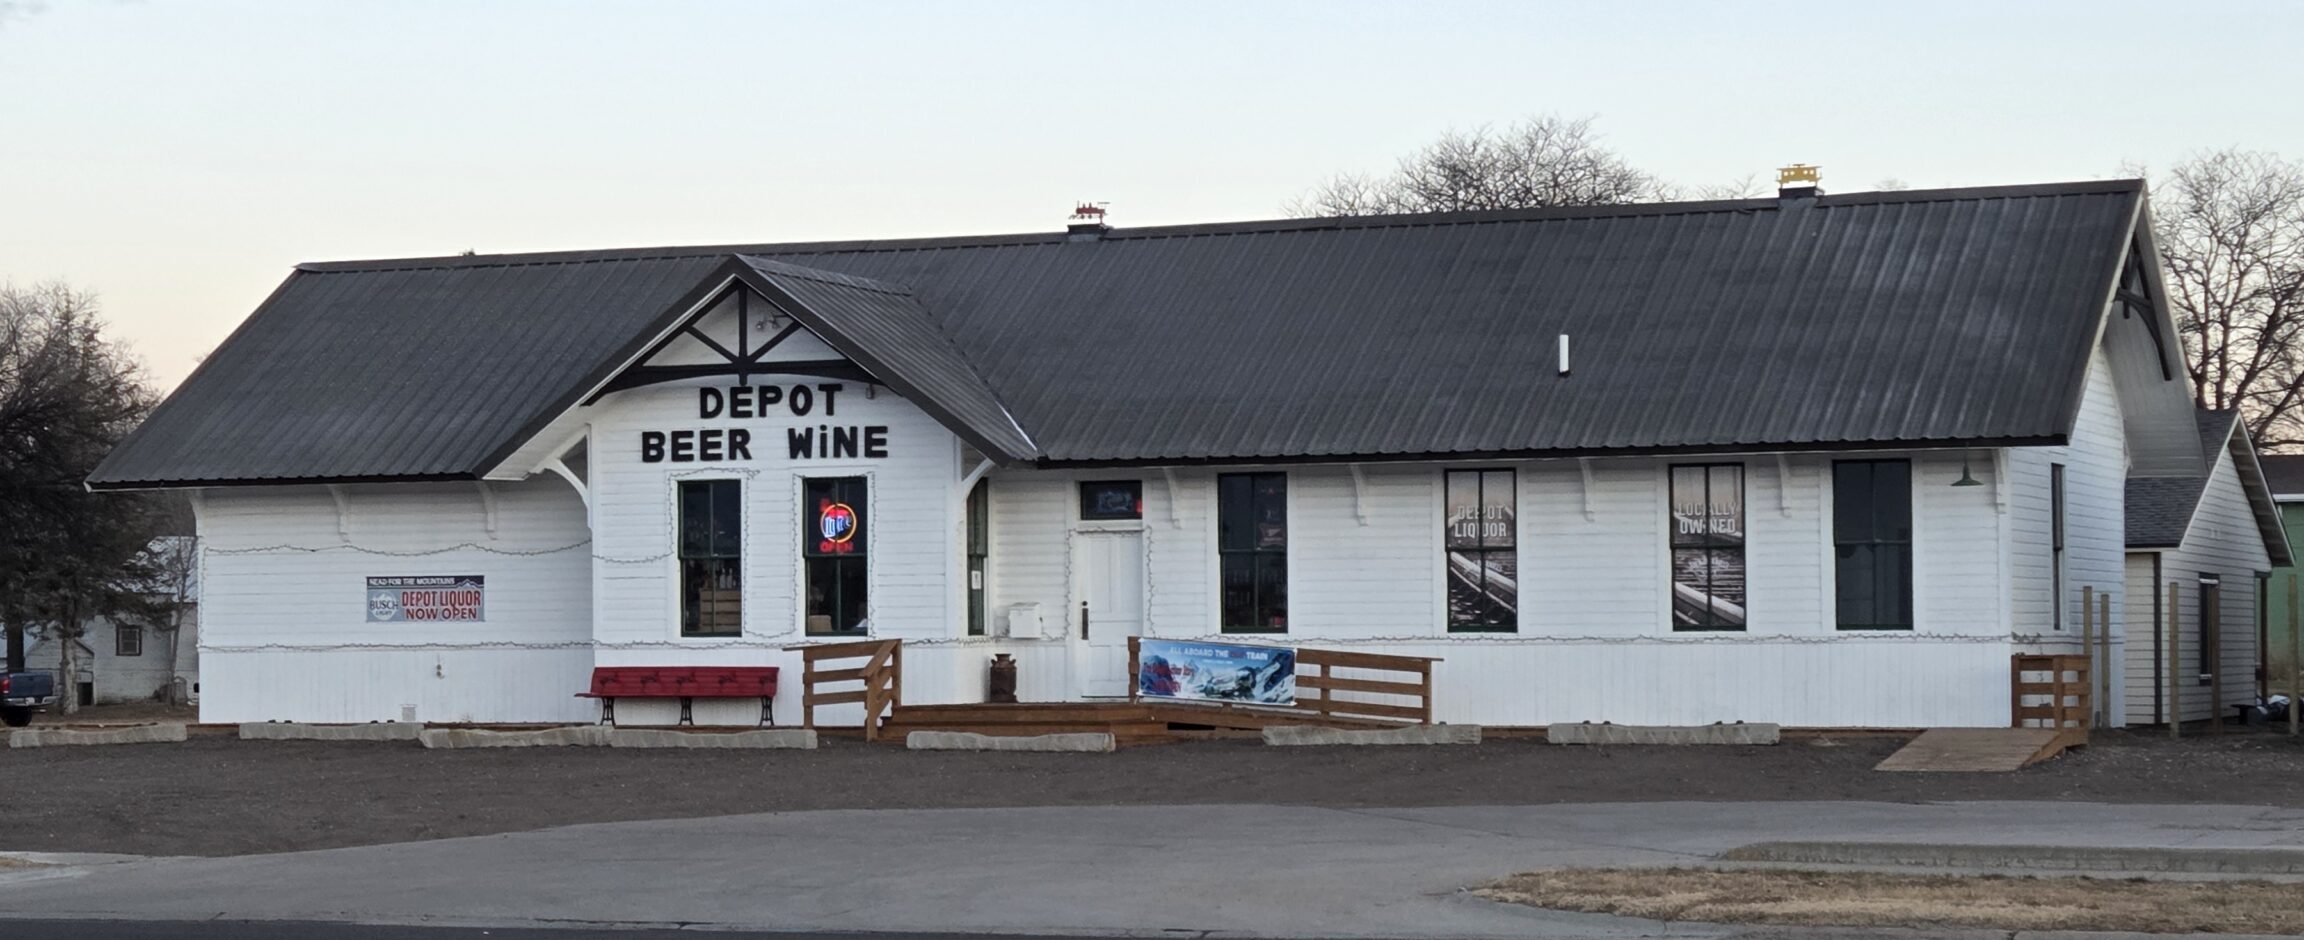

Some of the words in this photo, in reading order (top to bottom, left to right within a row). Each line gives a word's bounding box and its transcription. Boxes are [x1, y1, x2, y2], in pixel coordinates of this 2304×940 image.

[699, 383, 843, 419] DEPOT
[641, 428, 753, 463] BEER
[1456, 505, 1505, 520] DEPOT
[1678, 502, 1737, 516] LOCALLY
[1454, 522, 1507, 539] LIQUOR
[1679, 518, 1736, 534] OWNED
[819, 541, 854, 554] OPEN
[369, 578, 388, 586] HEAD
[388, 578, 402, 586] FOR
[403, 578, 415, 586] THE
[416, 577, 455, 585] MOUNTAINS
[369, 599, 399, 610] BUSCH
[401, 591, 437, 607] DEPOT
[439, 590, 481, 609] LIQUOR
[405, 608, 439, 620] NOW
[441, 607, 477, 620] OPEN
[1169, 647, 1182, 655] ALL
[1184, 648, 1214, 657] ABOARD
[1214, 649, 1229, 658] THE
[1246, 651, 1268, 661] TRAIN
